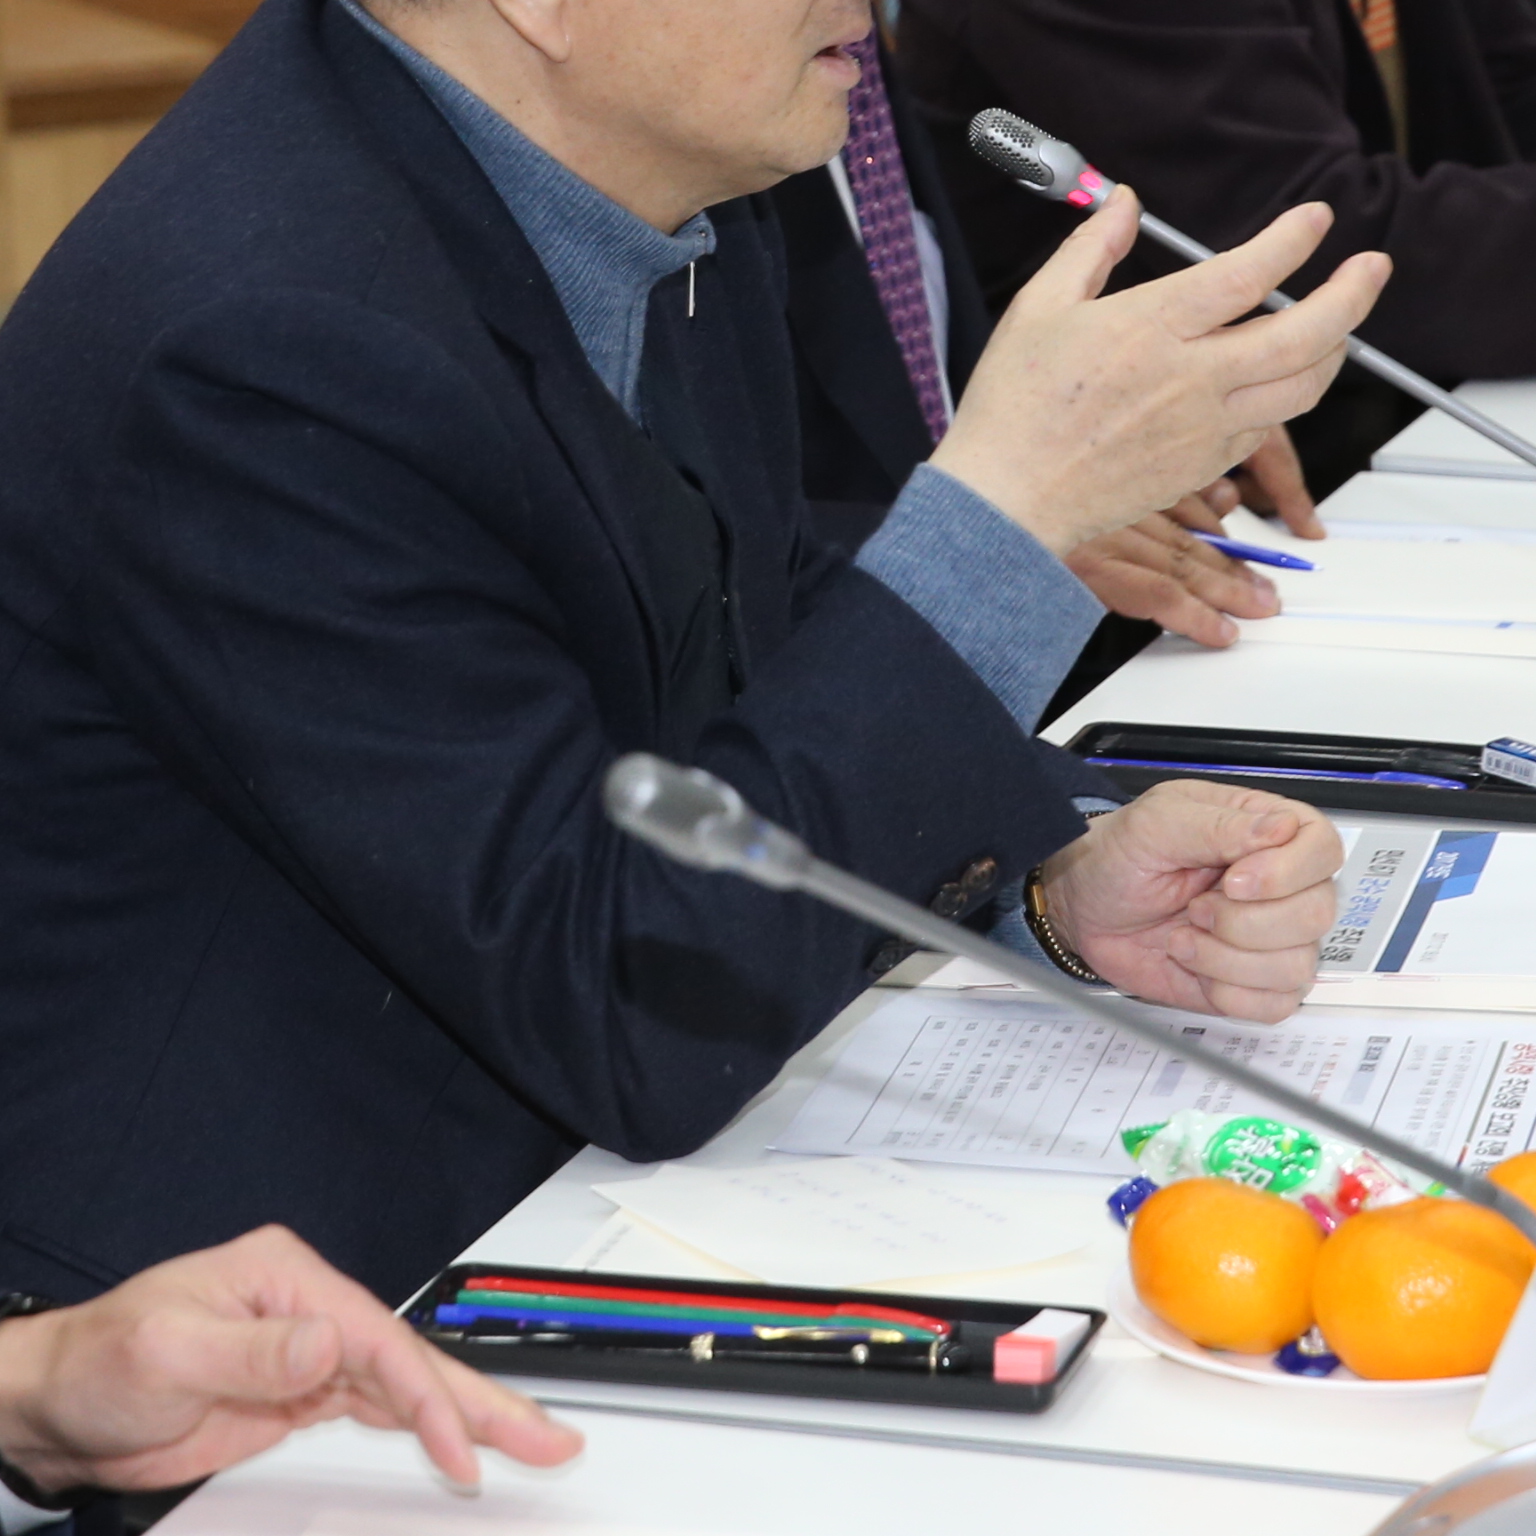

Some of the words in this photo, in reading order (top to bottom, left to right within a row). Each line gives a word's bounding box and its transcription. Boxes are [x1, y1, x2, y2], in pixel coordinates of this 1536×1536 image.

[1337, 895, 1383, 927] 공약사항
[1329, 928, 1366, 945] 추진
[1319, 945, 1358, 962] 상황
[1492, 1078, 1530, 1109] 추진상황
[1482, 1111, 1518, 1136] 보고회
